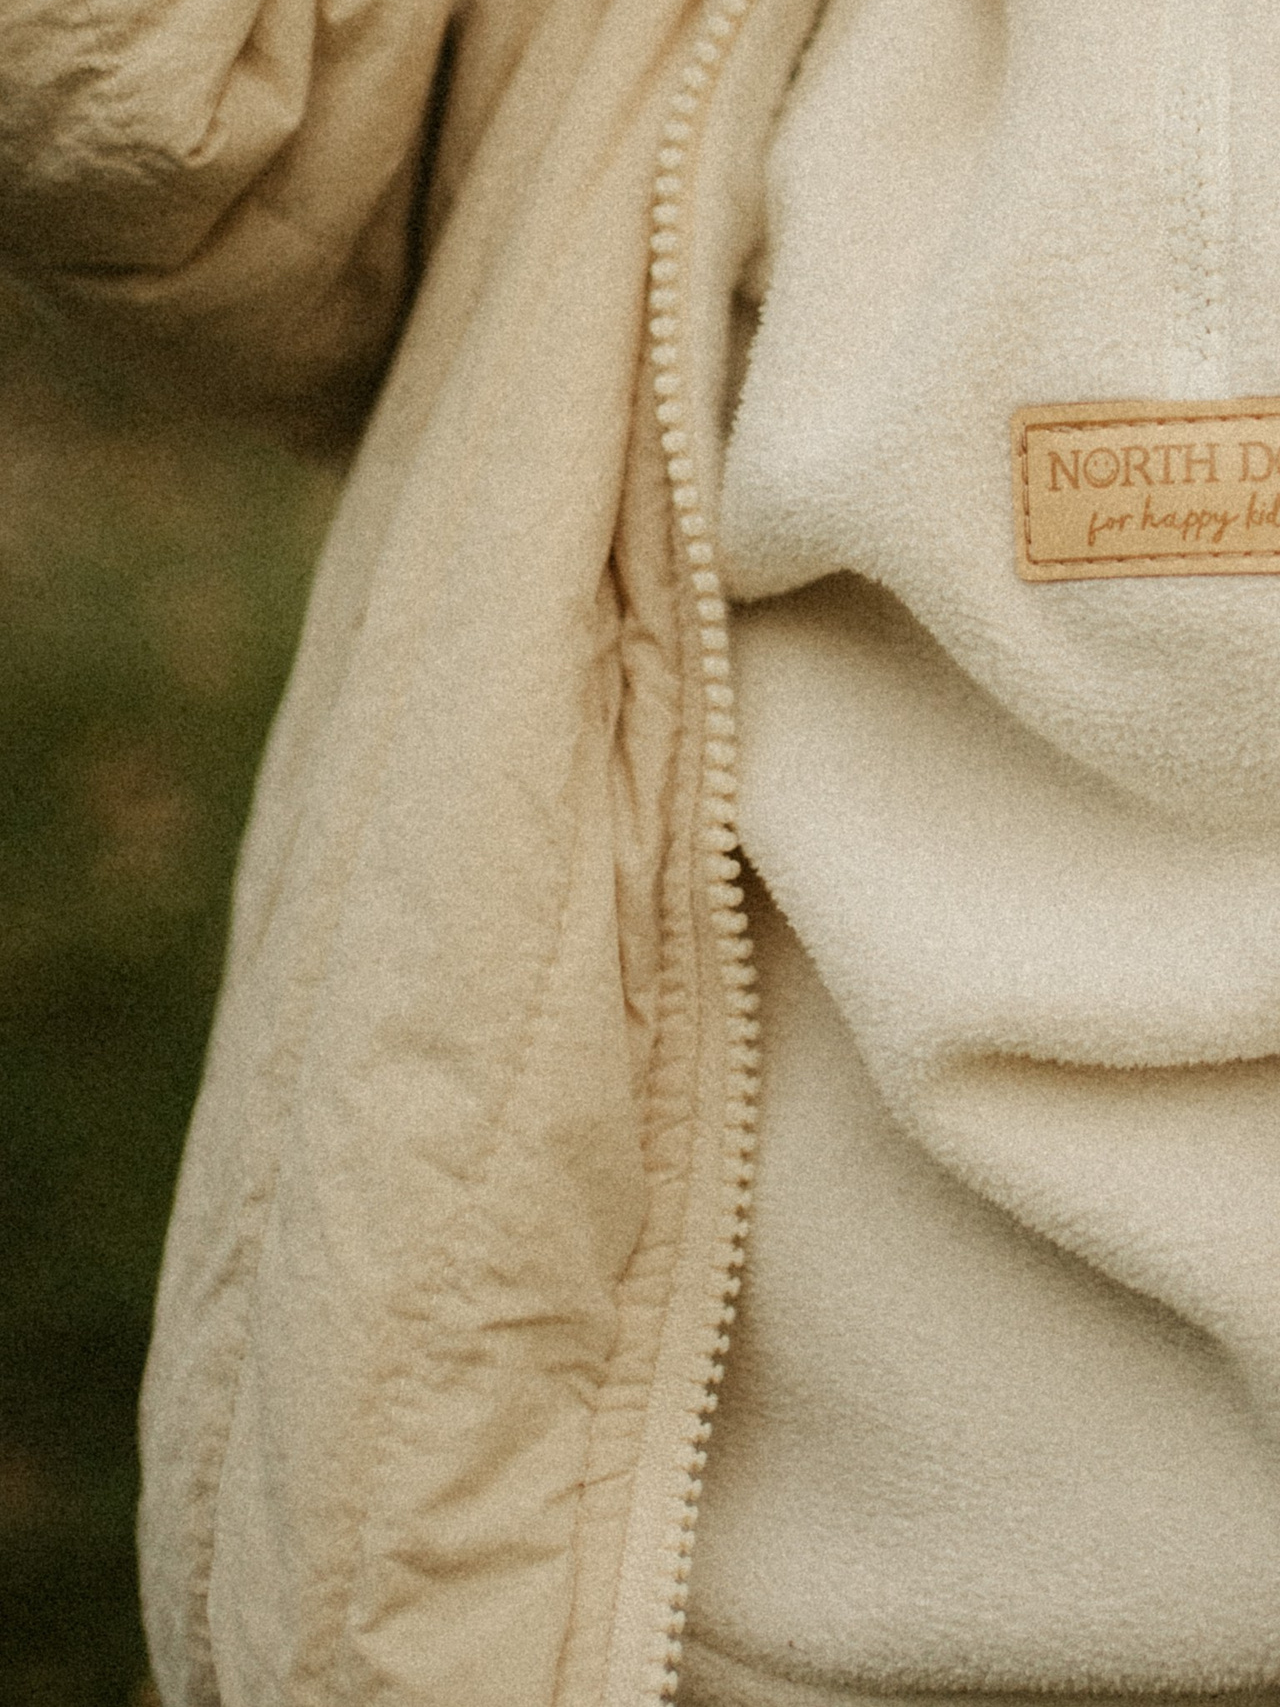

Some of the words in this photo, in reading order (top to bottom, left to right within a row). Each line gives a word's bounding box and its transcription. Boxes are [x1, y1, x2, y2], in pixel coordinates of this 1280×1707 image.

[1047, 442, 1221, 492] NORTH
[1086, 510, 1133, 547] for
[1141, 493, 1241, 543] happy
